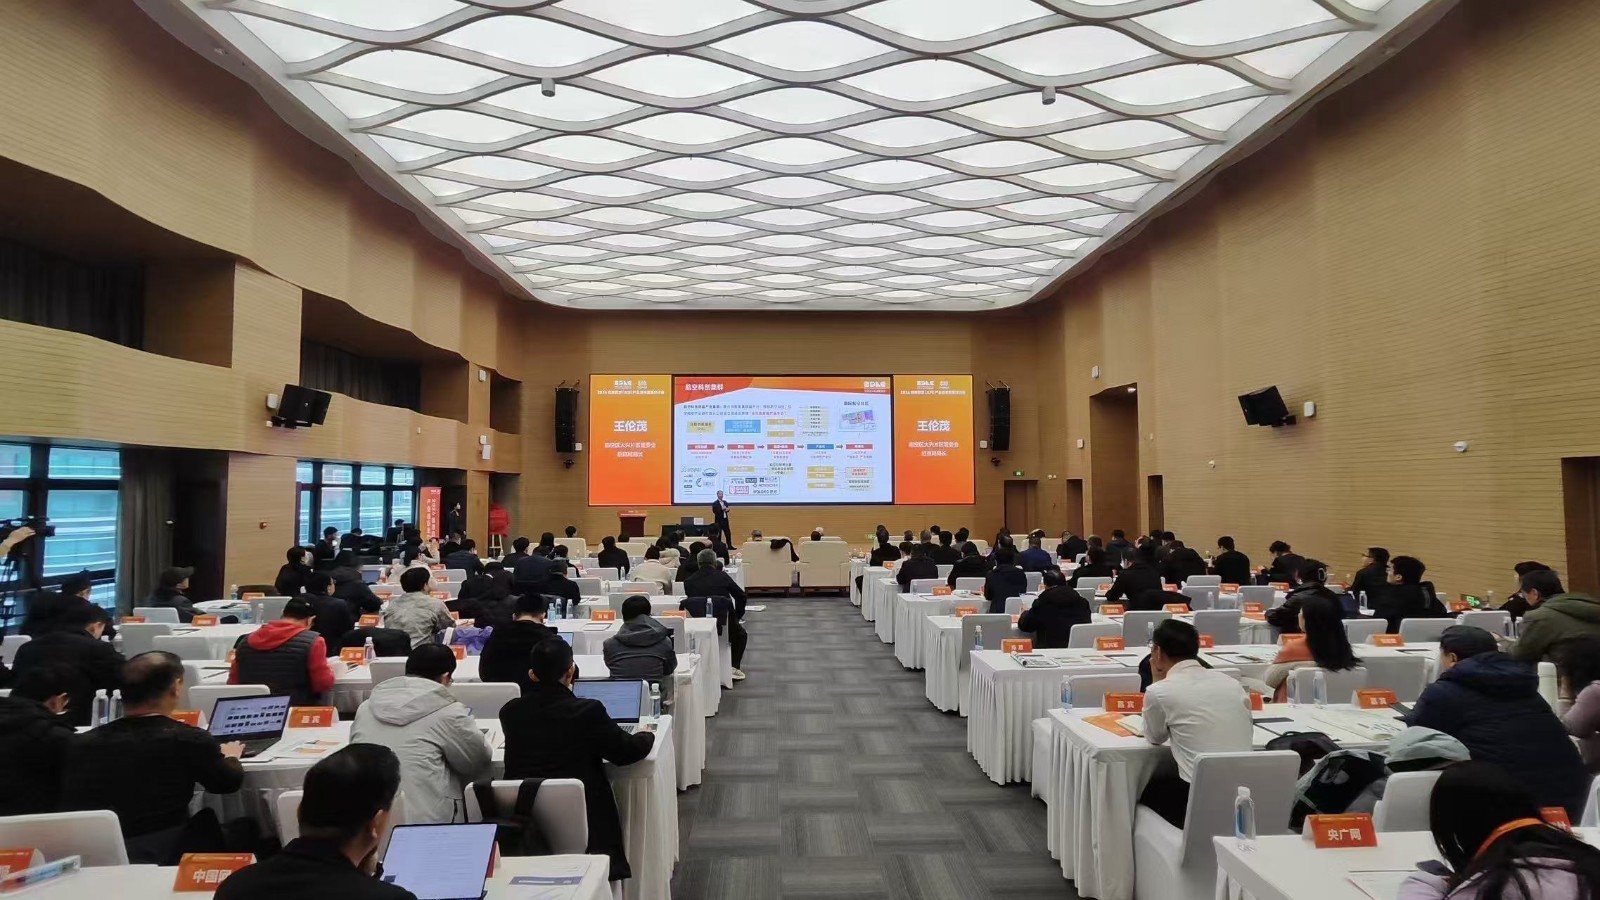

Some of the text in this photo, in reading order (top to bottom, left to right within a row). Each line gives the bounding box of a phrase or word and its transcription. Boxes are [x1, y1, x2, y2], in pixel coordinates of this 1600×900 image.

[614, 420, 648, 432] 王伦茂
[917, 420, 951, 432] 王伦茂
[1117, 700, 1135, 709] 嘉宾
[1327, 828, 1362, 841] 央广网
[192, 868, 232, 884] 中国网
